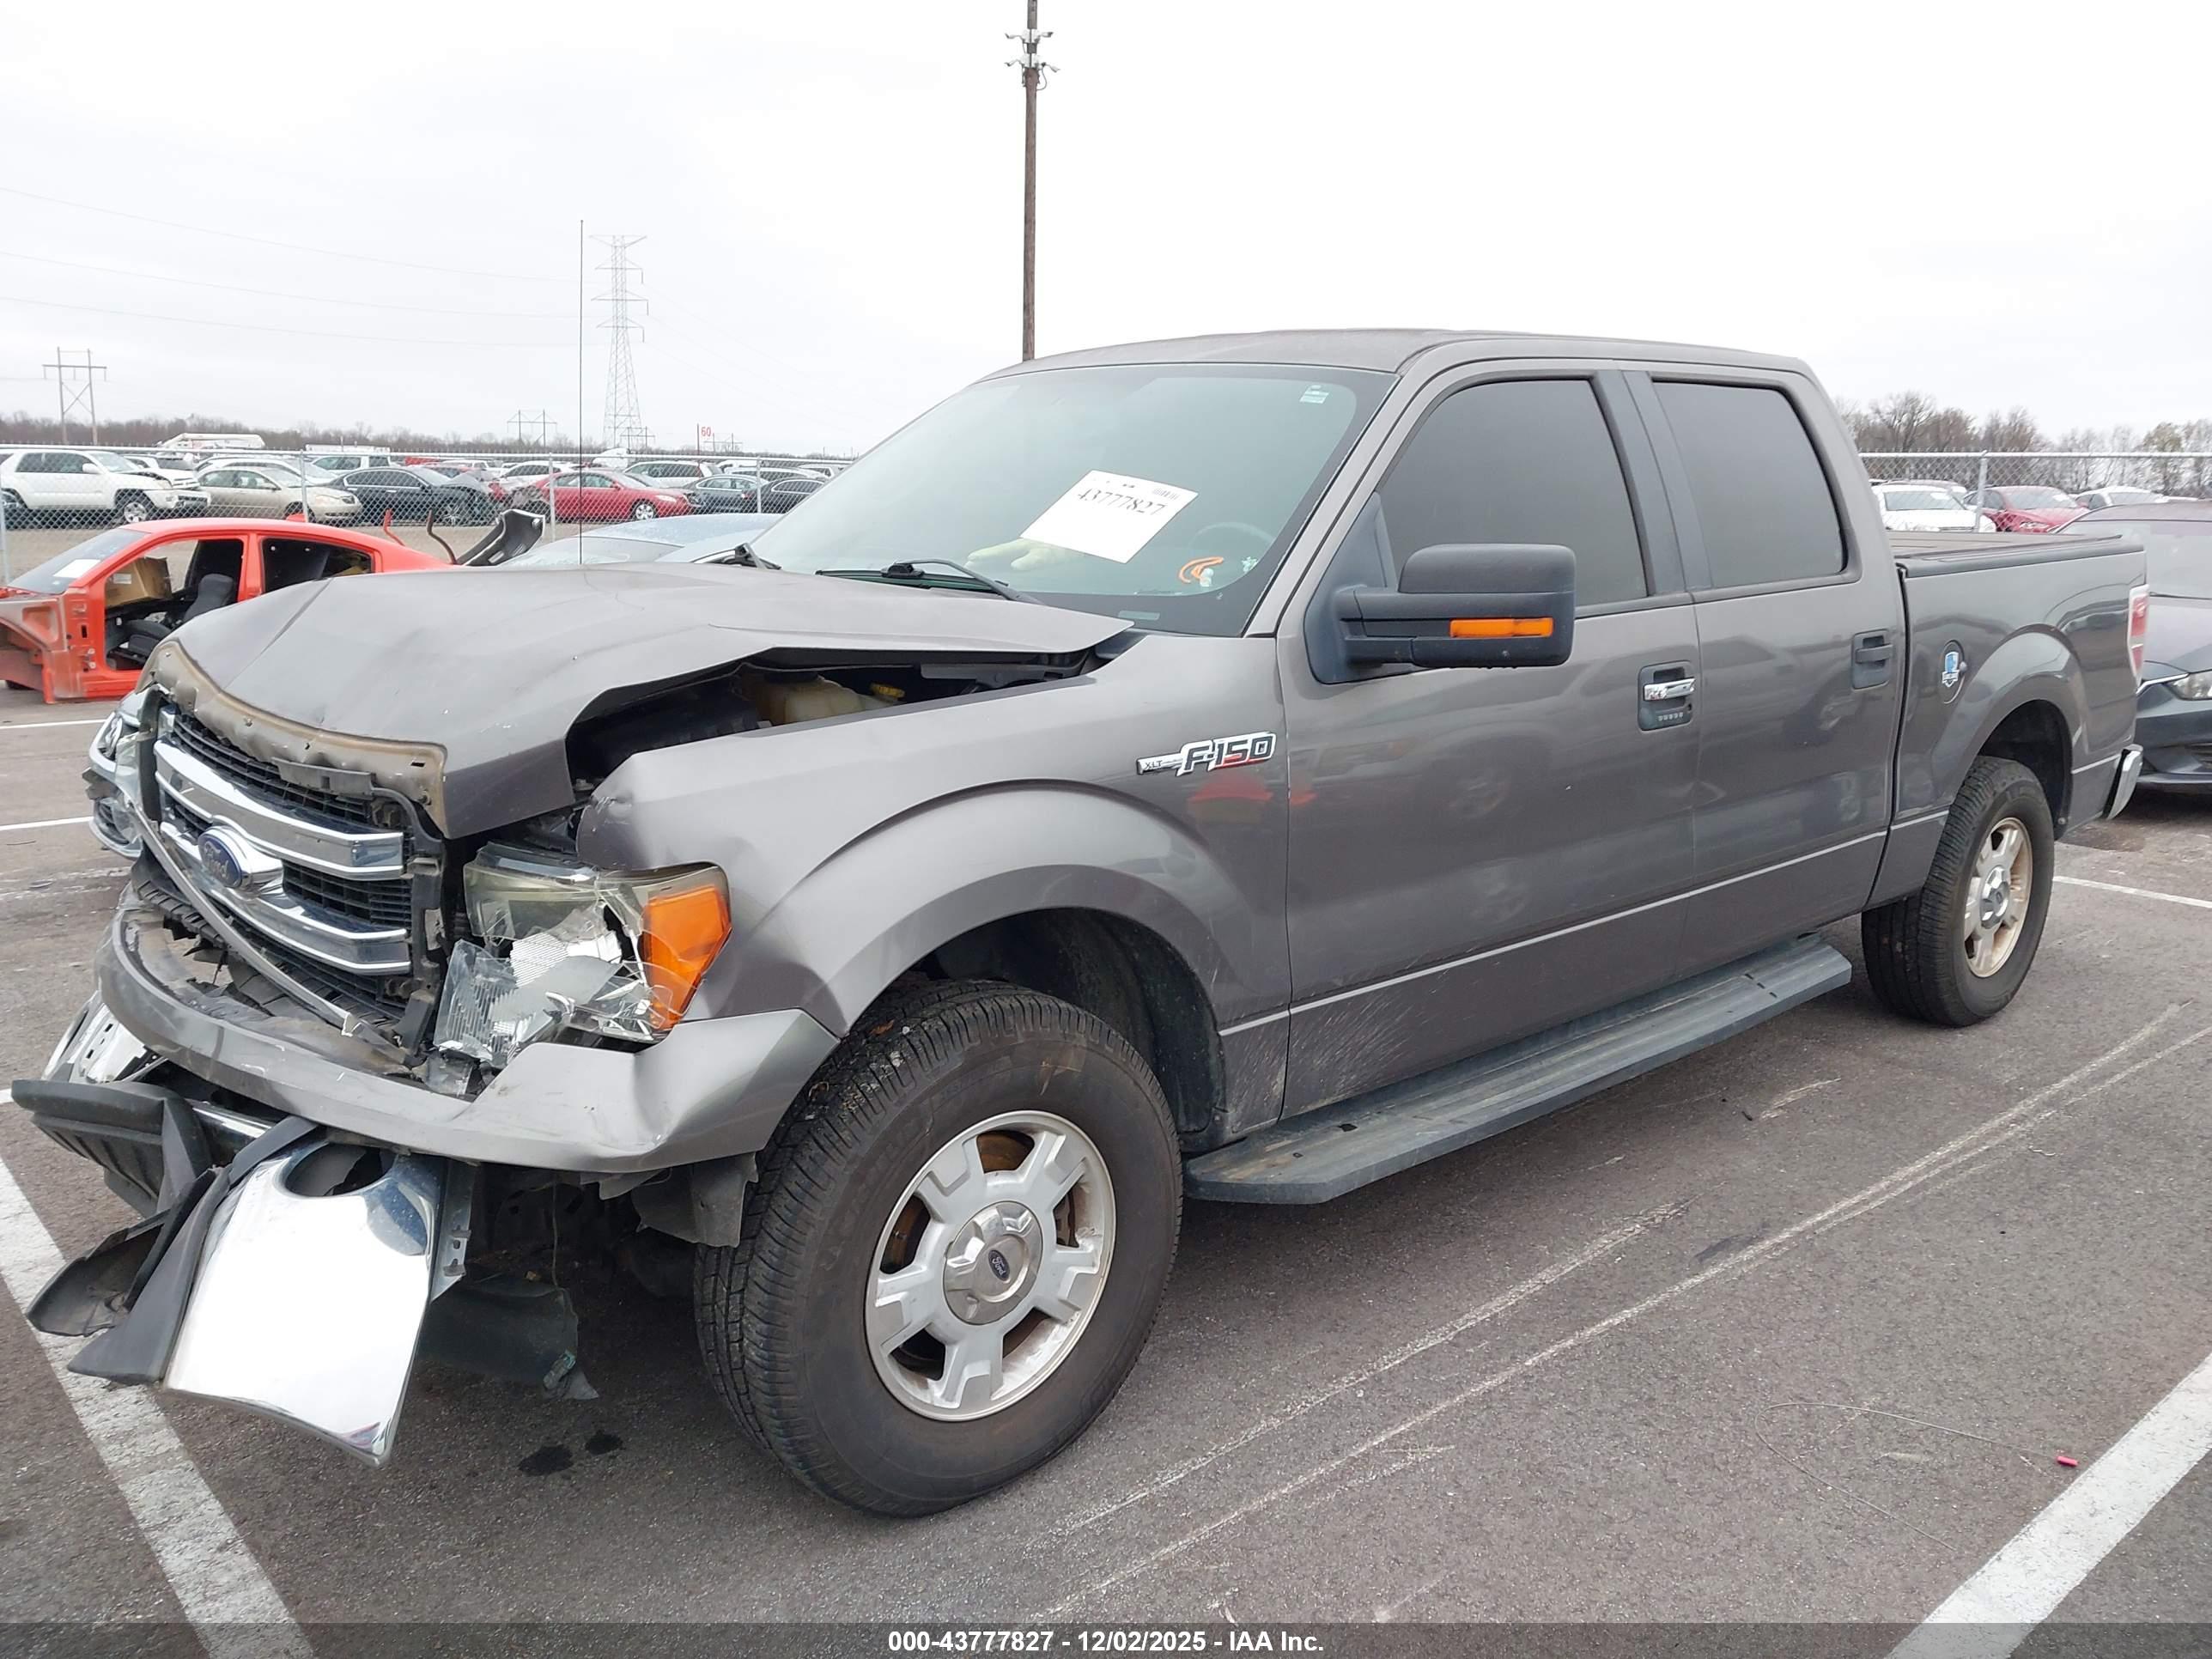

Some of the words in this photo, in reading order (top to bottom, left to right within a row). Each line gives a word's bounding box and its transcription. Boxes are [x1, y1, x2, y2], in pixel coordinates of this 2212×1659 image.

[701, 426, 712, 437] 60
[1077, 488, 1166, 515] 43777827
[1145, 759, 1163, 771] XLT
[1179, 732, 1276, 775] F-150
[204, 841, 229, 879] Ford
[992, 1256, 1006, 1276] Ford
